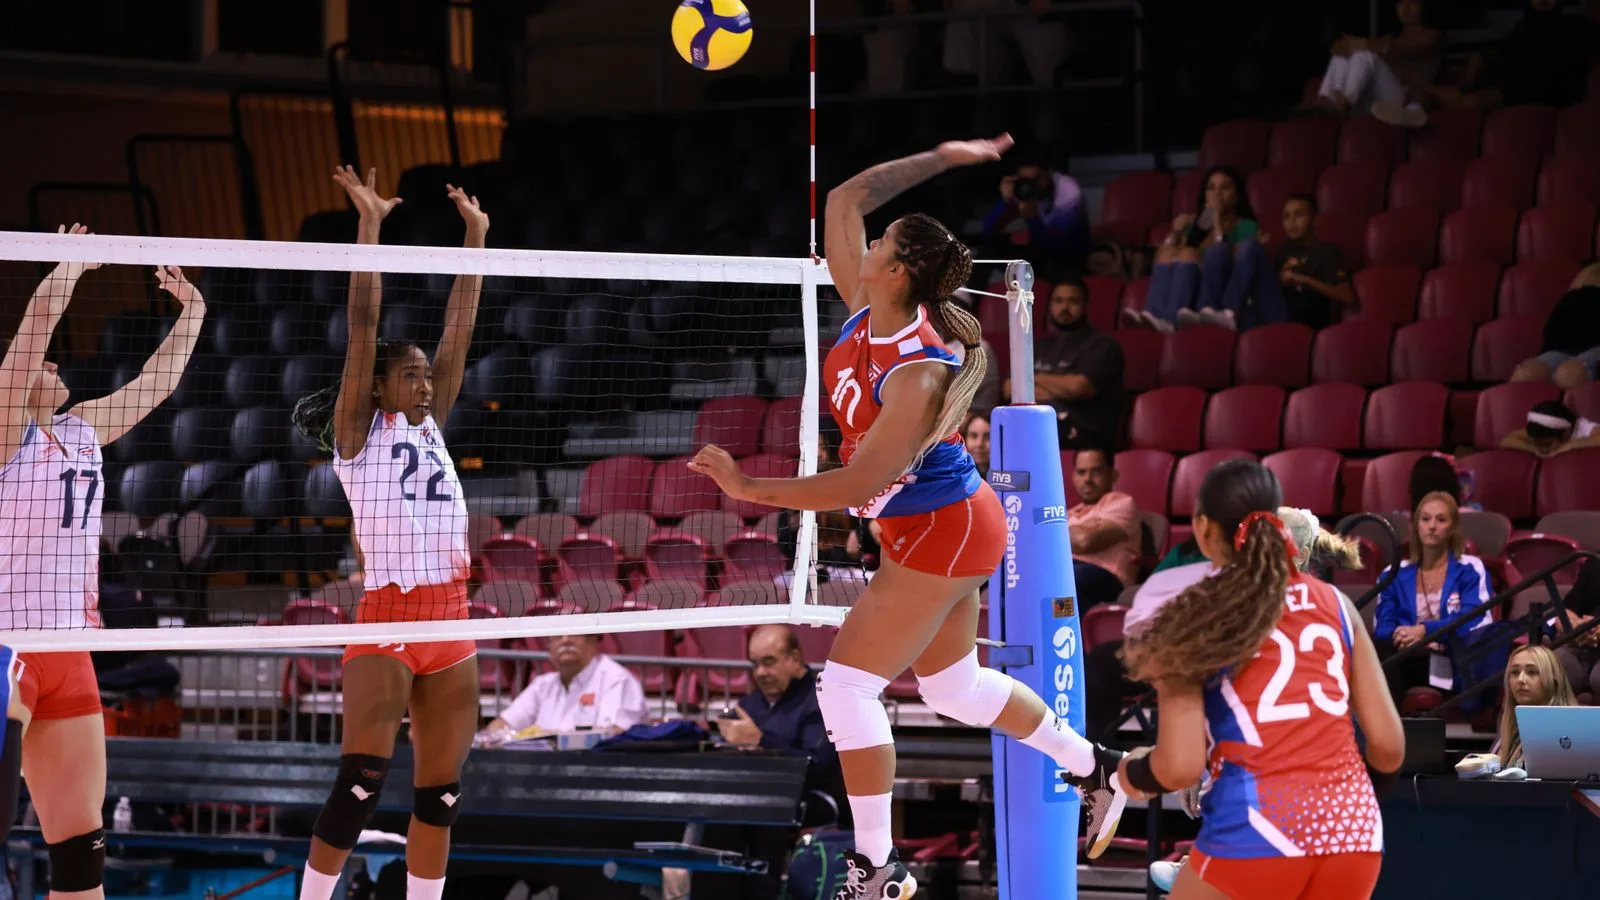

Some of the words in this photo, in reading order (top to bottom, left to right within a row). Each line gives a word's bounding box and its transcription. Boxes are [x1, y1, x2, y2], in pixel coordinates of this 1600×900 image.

[59, 467, 98, 530] 17
[392, 442, 452, 501] 22
[992, 472, 1012, 483] FIVB
[1043, 505, 1066, 518] FIVB
[1006, 515, 1020, 589] Senoh
[1252, 623, 1349, 723] 23
